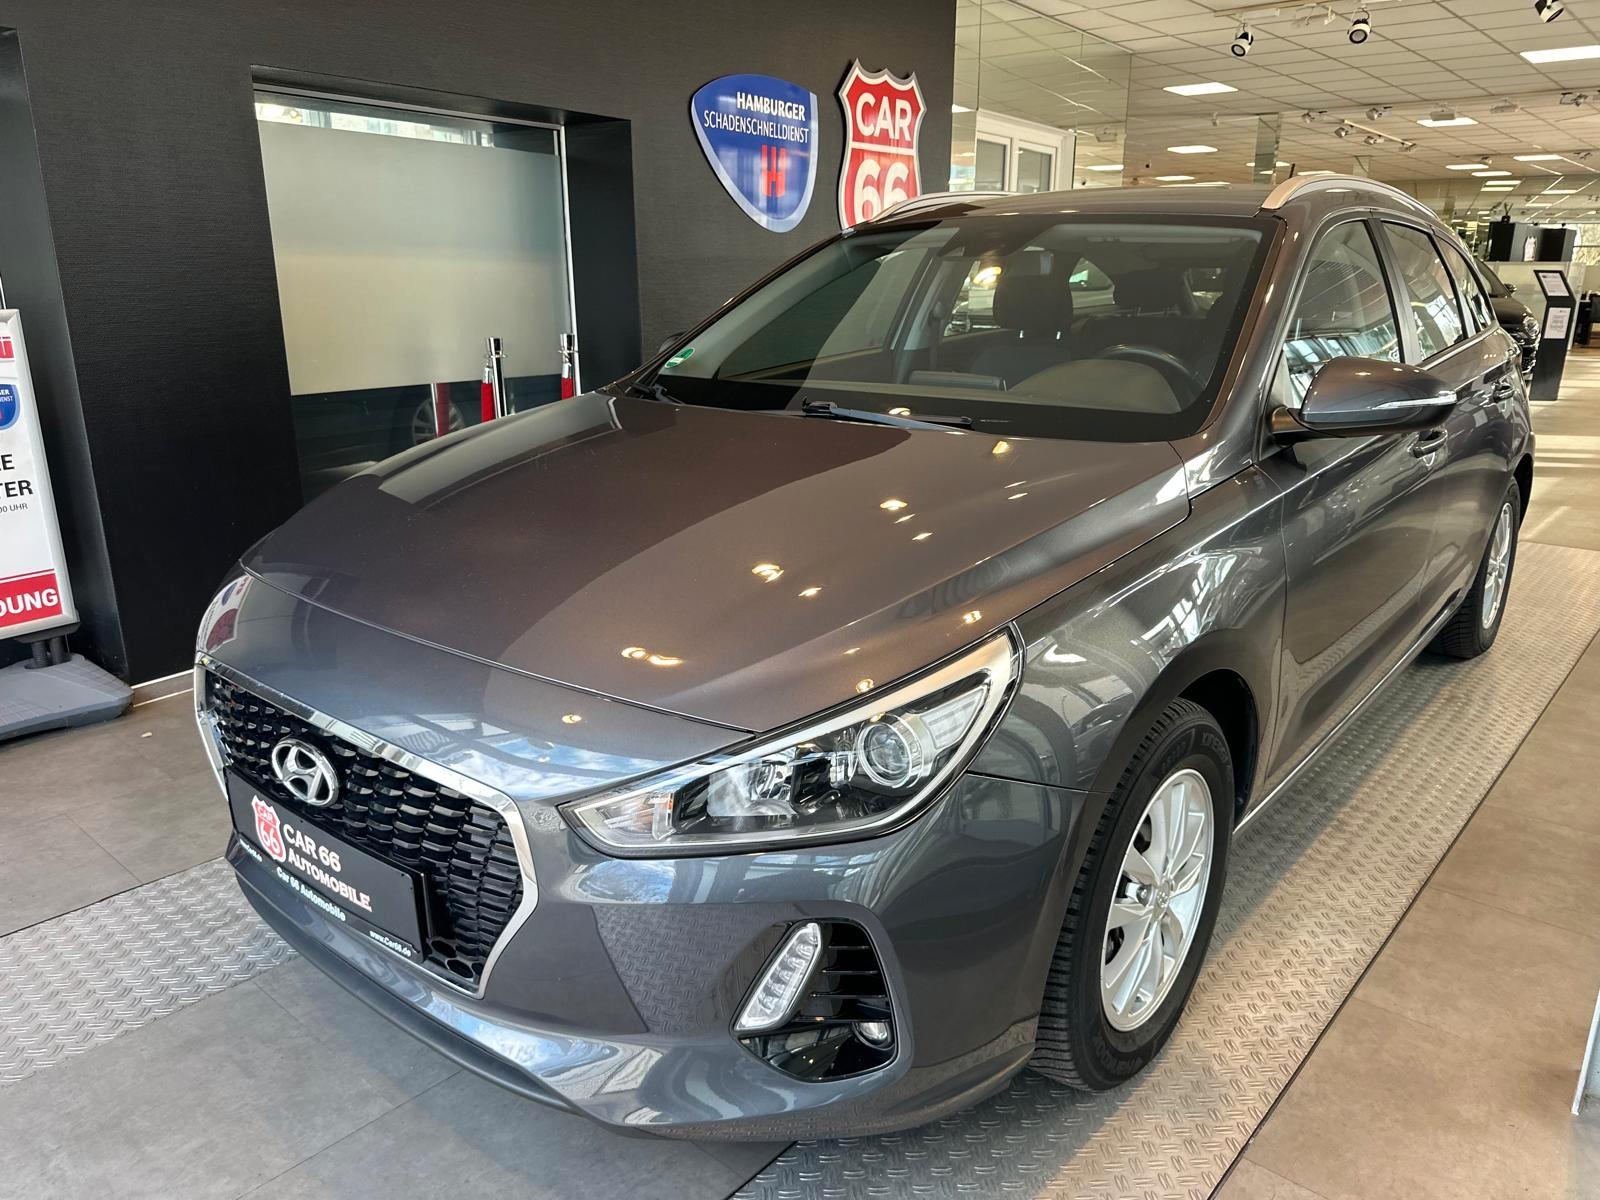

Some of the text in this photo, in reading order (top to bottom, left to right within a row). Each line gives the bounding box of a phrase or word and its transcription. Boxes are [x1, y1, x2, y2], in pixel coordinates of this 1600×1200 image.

[737, 91, 805, 121] HAMBURGER
[856, 92, 912, 141] CAR
[704, 110, 809, 144] SCHADENSCHNELLDIENST
[854, 158, 909, 221] 66
[0, 454, 15, 471] E
[0, 480, 33, 498] ER
[9, 502, 28, 512] UHR
[260, 821, 280, 855] 66
[283, 824, 317, 859] CAR
[319, 845, 341, 872] 66
[276, 866, 290, 883] Car
[300, 884, 346, 921] Automobile
[288, 849, 372, 912] AUTOMOBILE
